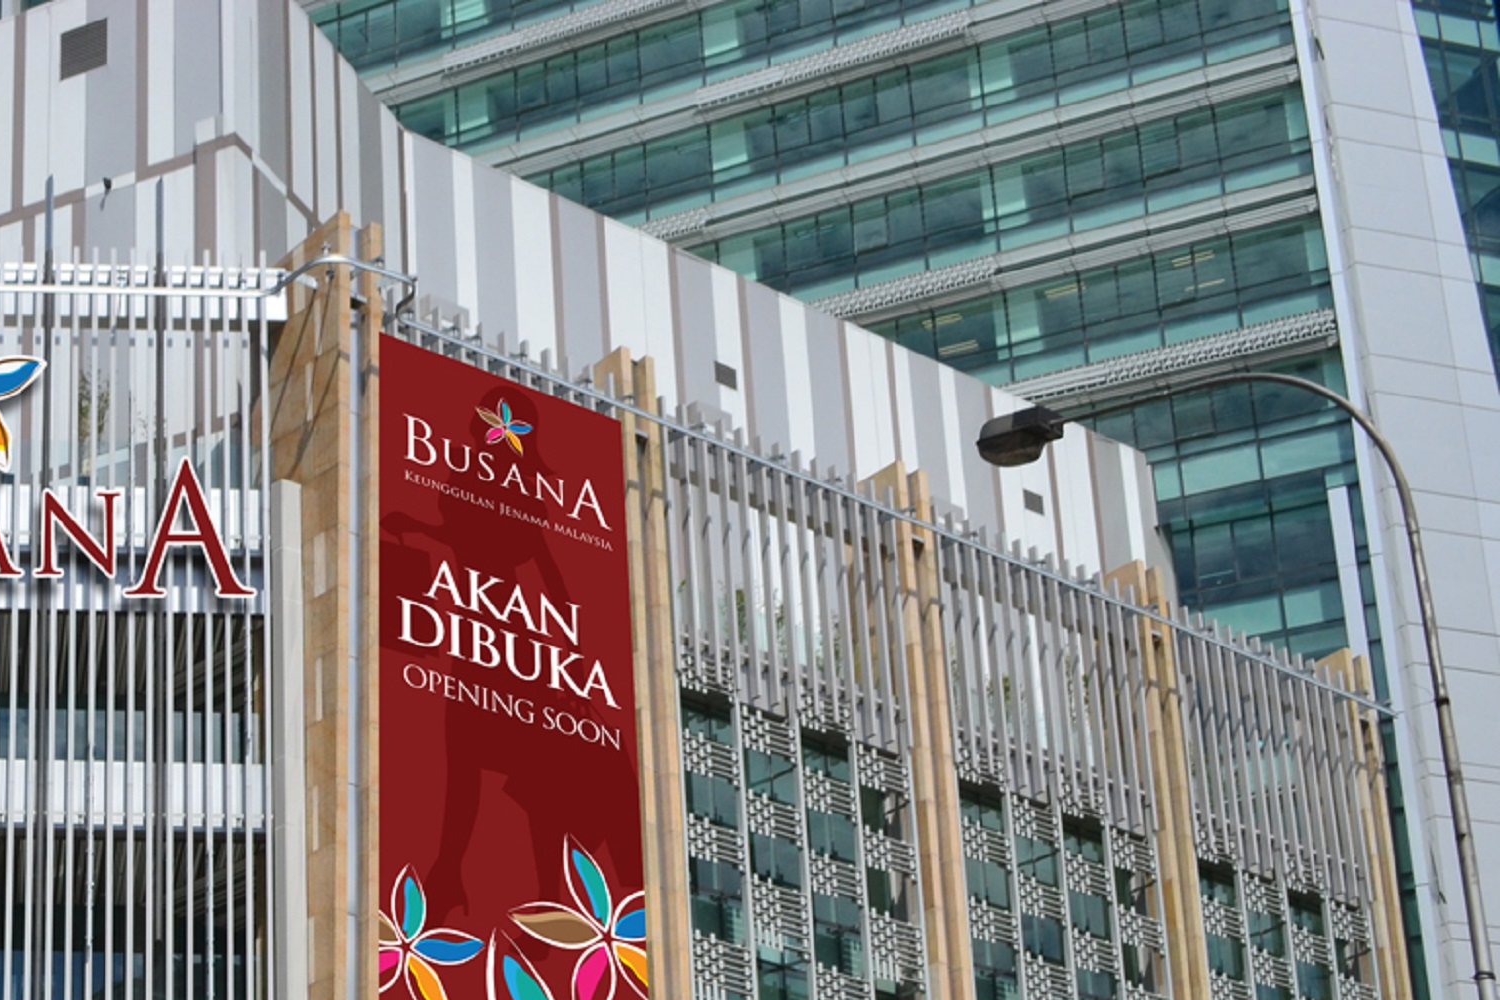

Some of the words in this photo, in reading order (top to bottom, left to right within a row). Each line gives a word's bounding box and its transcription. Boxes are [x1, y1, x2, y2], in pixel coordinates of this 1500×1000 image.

[403, 413, 612, 531] BUSANA
[404, 470, 496, 510] KEUNGGULAN
[499, 501, 551, 530] JENAMA
[554, 523, 614, 552] MALAYSIA
[423, 560, 580, 645] AKAN
[397, 596, 621, 709] DIBUKA
[403, 663, 534, 724] OPENING
[542, 707, 620, 750] SOON
